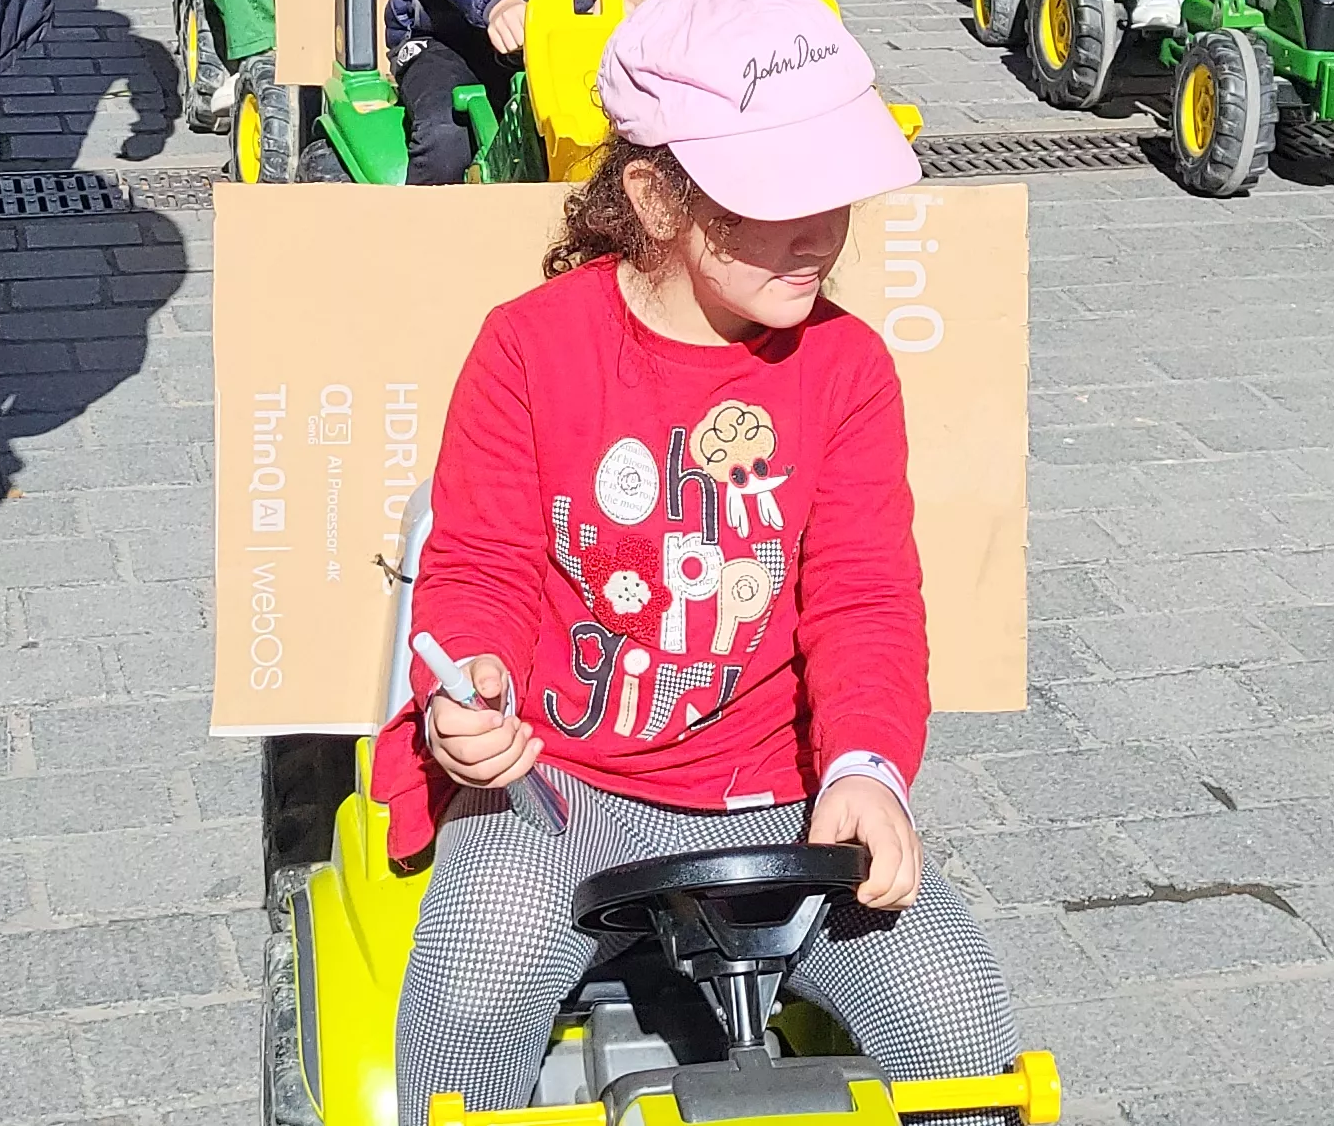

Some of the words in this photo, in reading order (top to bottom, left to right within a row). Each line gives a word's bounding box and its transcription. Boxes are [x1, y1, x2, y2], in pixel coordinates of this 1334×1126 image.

[740, 49, 795, 114] John
[793, 34, 839, 70] Deere
[883, 190, 945, 353] hinQ
[248, 383, 287, 492] ThinQ
[326, 455, 343, 475] AI
[326, 477, 343, 556] Processor
[326, 560, 342, 583] 4K
[250, 561, 284, 692] webOS
